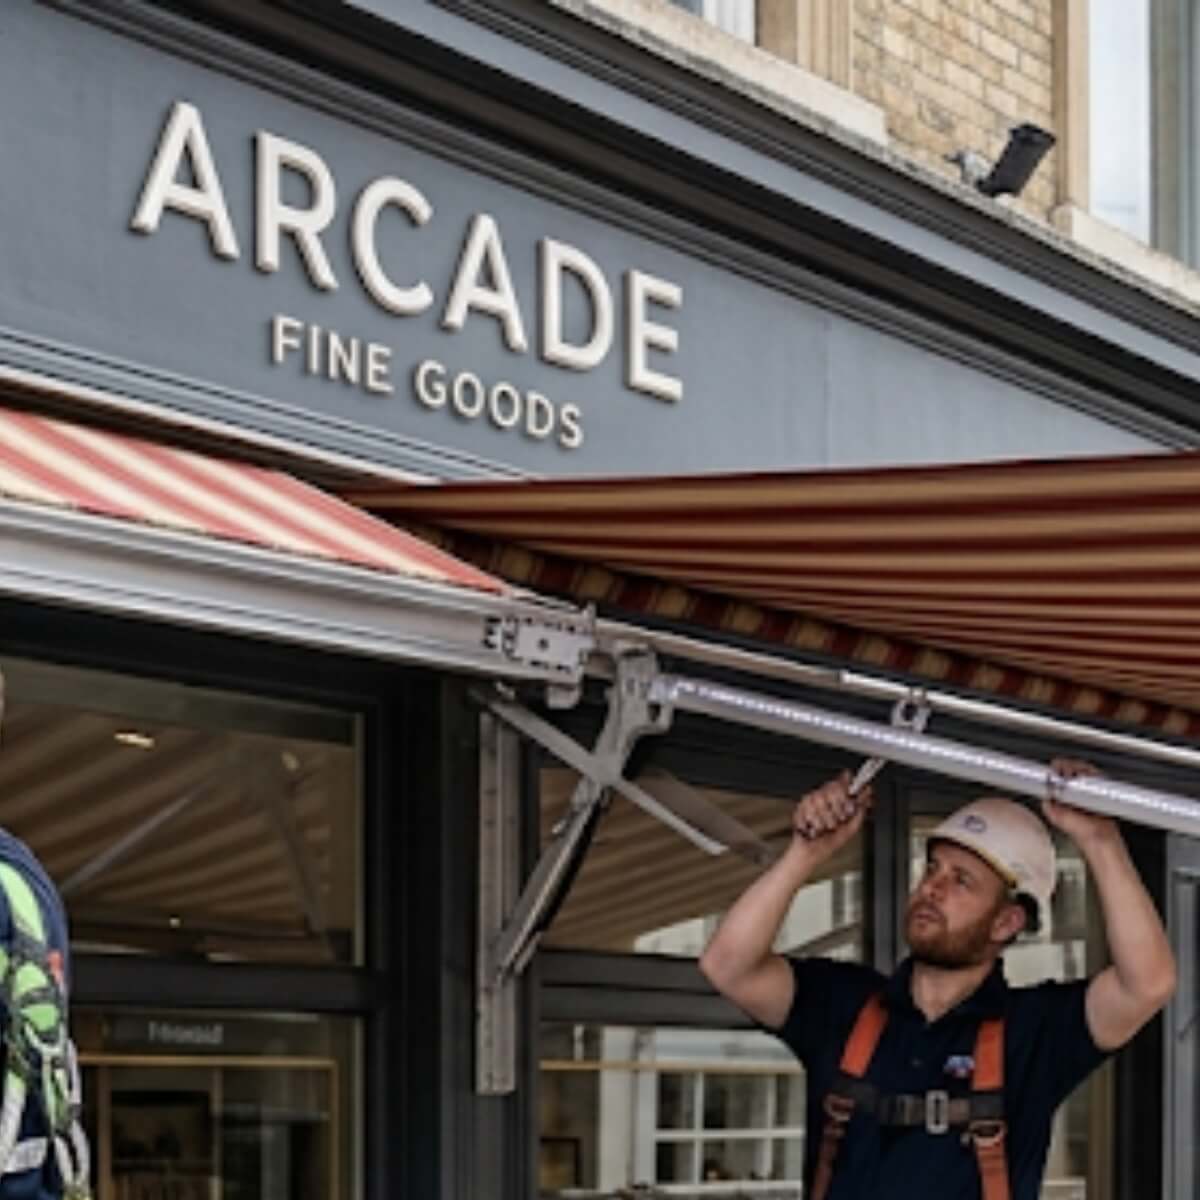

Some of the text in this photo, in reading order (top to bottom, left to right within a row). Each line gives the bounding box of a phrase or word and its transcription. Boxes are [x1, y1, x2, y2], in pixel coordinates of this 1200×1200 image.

[129, 101, 684, 400] ARCADE
[270, 315, 584, 448] FINE GOODS
